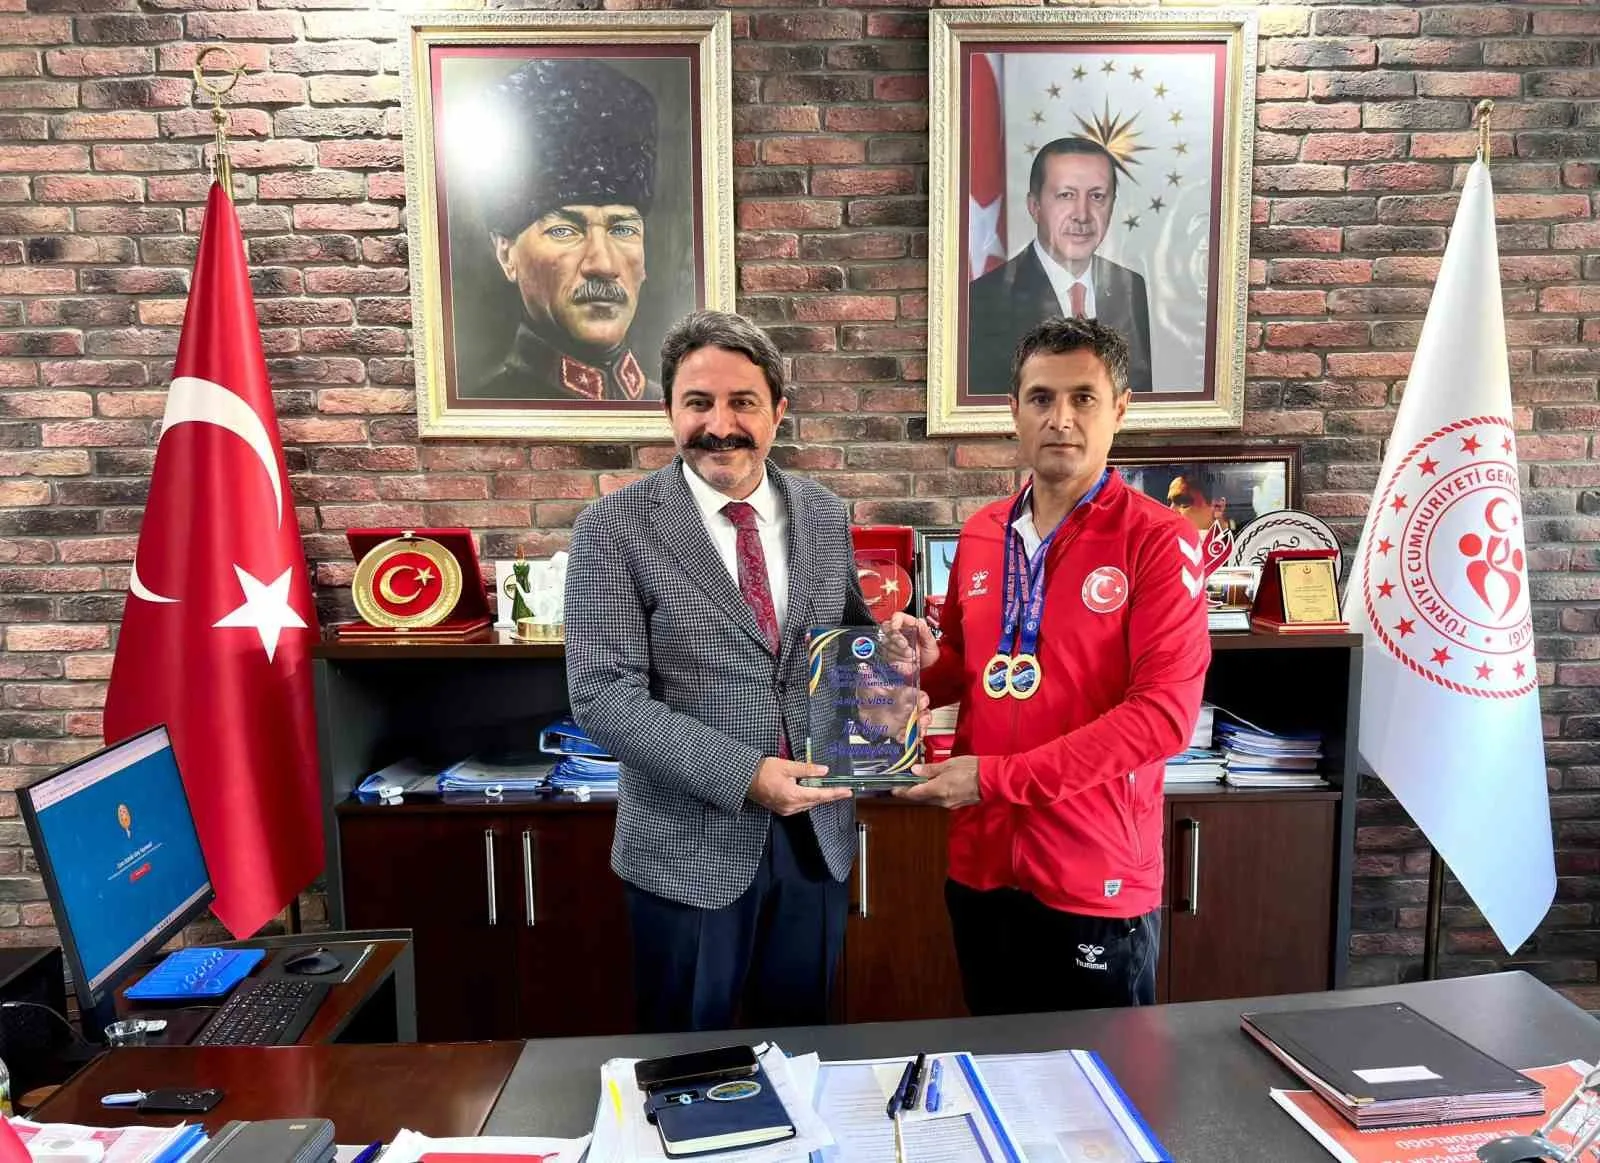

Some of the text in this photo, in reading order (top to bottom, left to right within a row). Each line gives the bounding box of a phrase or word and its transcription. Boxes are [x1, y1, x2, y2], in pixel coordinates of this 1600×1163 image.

[1407, 468, 1480, 572] CUMHURİYETİ
[1411, 576, 1468, 638] TÜRKİYE
[1075, 957, 1107, 970] hummel
